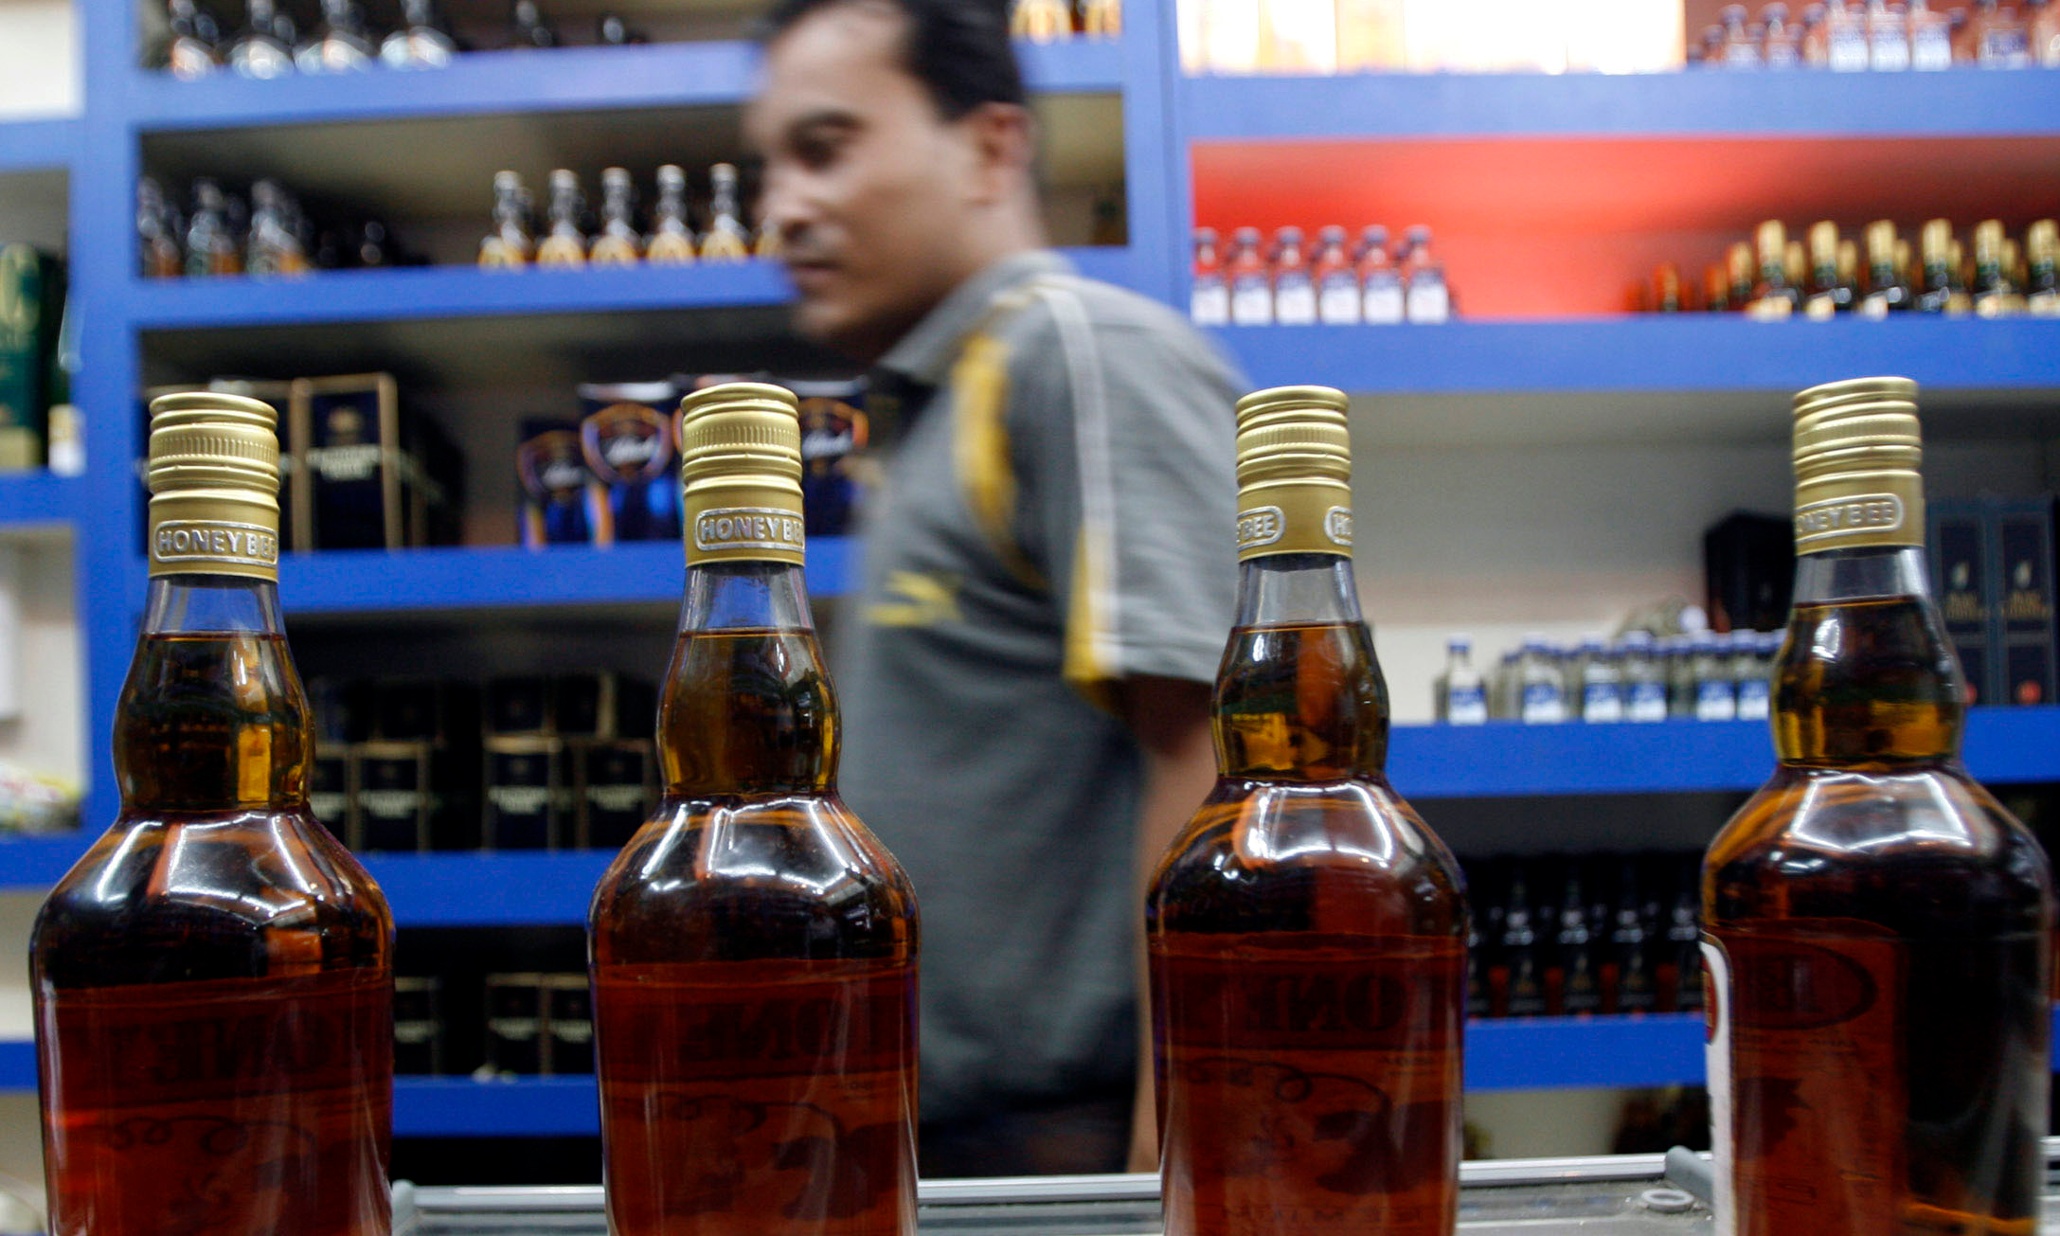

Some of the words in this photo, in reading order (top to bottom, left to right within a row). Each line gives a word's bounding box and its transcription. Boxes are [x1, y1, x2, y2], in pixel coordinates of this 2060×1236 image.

[1846, 501, 1895, 526] BEE
[157, 528, 242, 554] HONEY
[700, 515, 780, 542] HONEY
